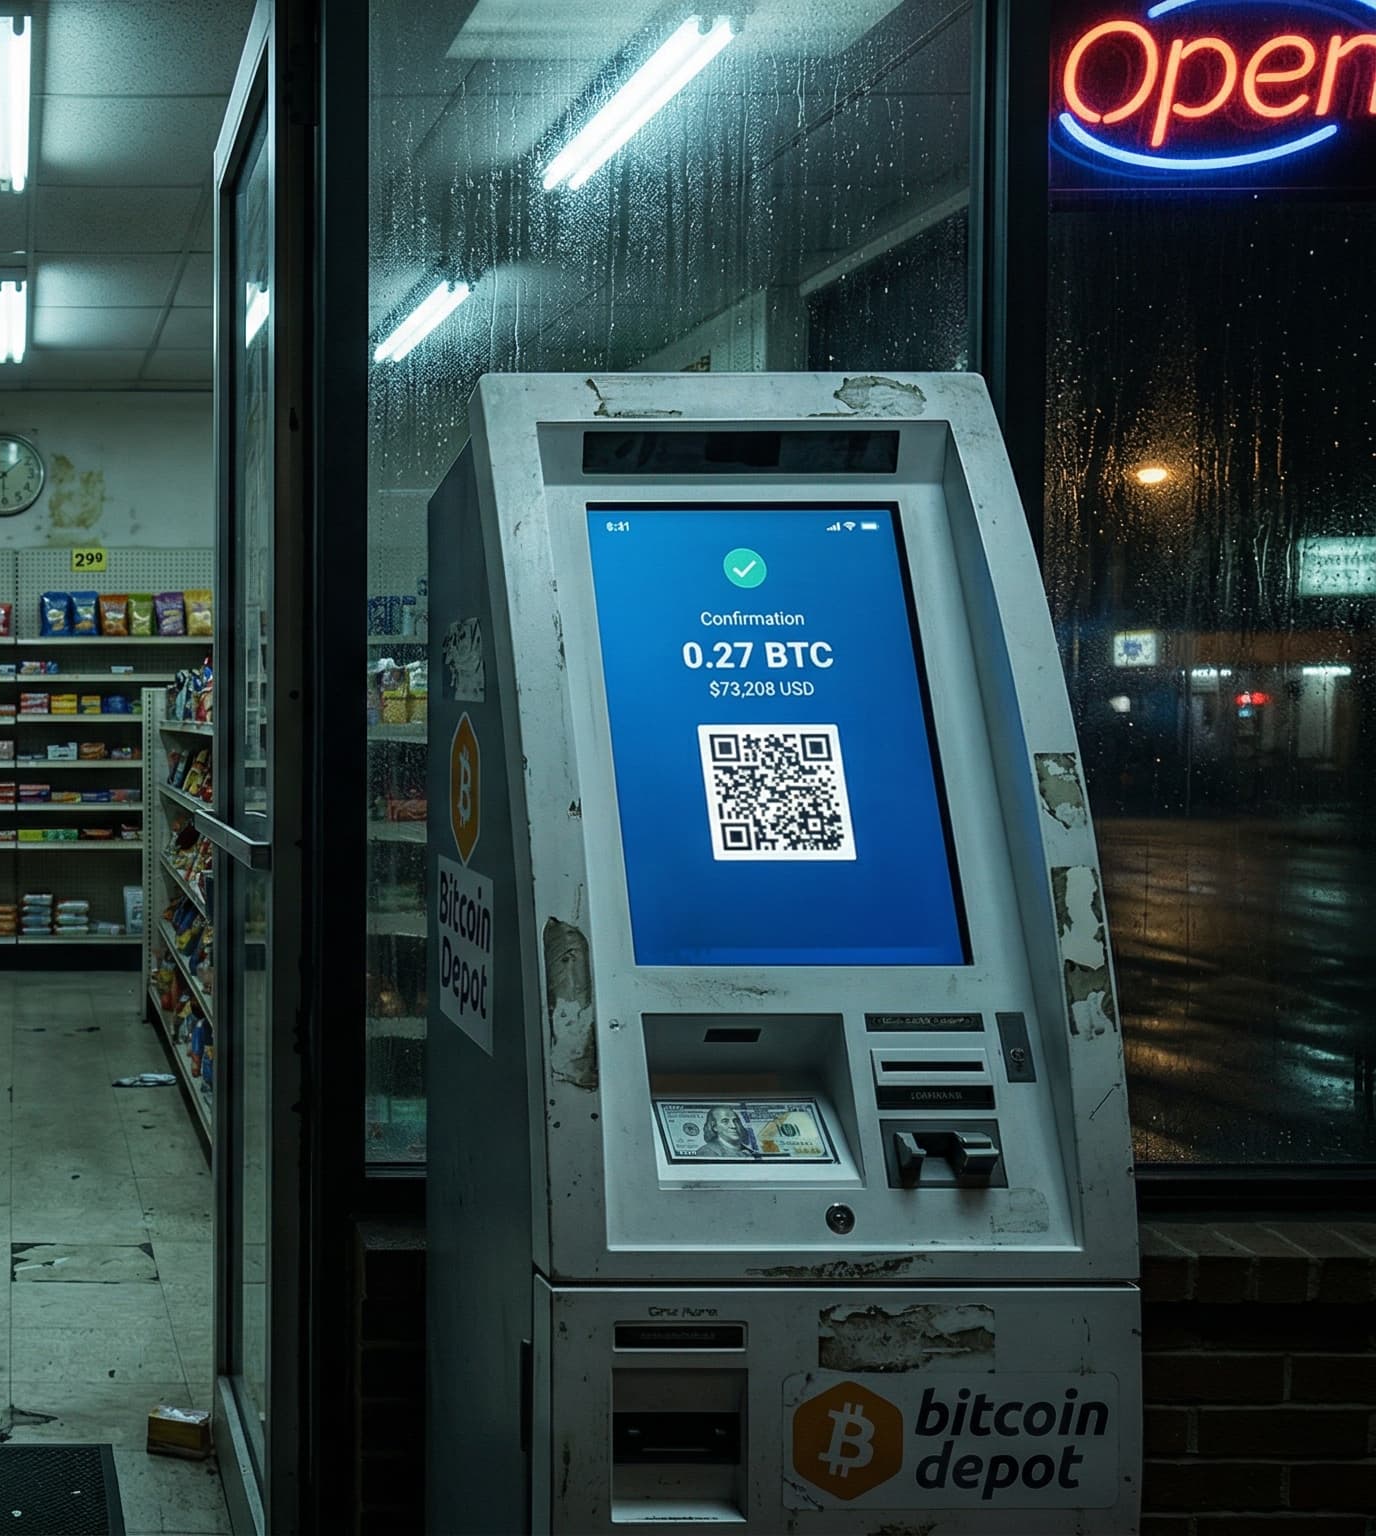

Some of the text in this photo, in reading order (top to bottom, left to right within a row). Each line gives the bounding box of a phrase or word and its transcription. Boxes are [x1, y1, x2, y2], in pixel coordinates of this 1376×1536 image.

[1063, 20, 1376, 147] Open
[75, 552, 103, 567] 299
[700, 611, 805, 626] Confirmation
[682, 641, 834, 669] 0.27 BTC
[709, 680, 815, 698] $73,208 USD
[439, 870, 491, 953] Bitcoin
[441, 935, 487, 1019] Depot
[915, 1387, 1109, 1437] bitcoin
[915, 1439, 1084, 1501] depot
